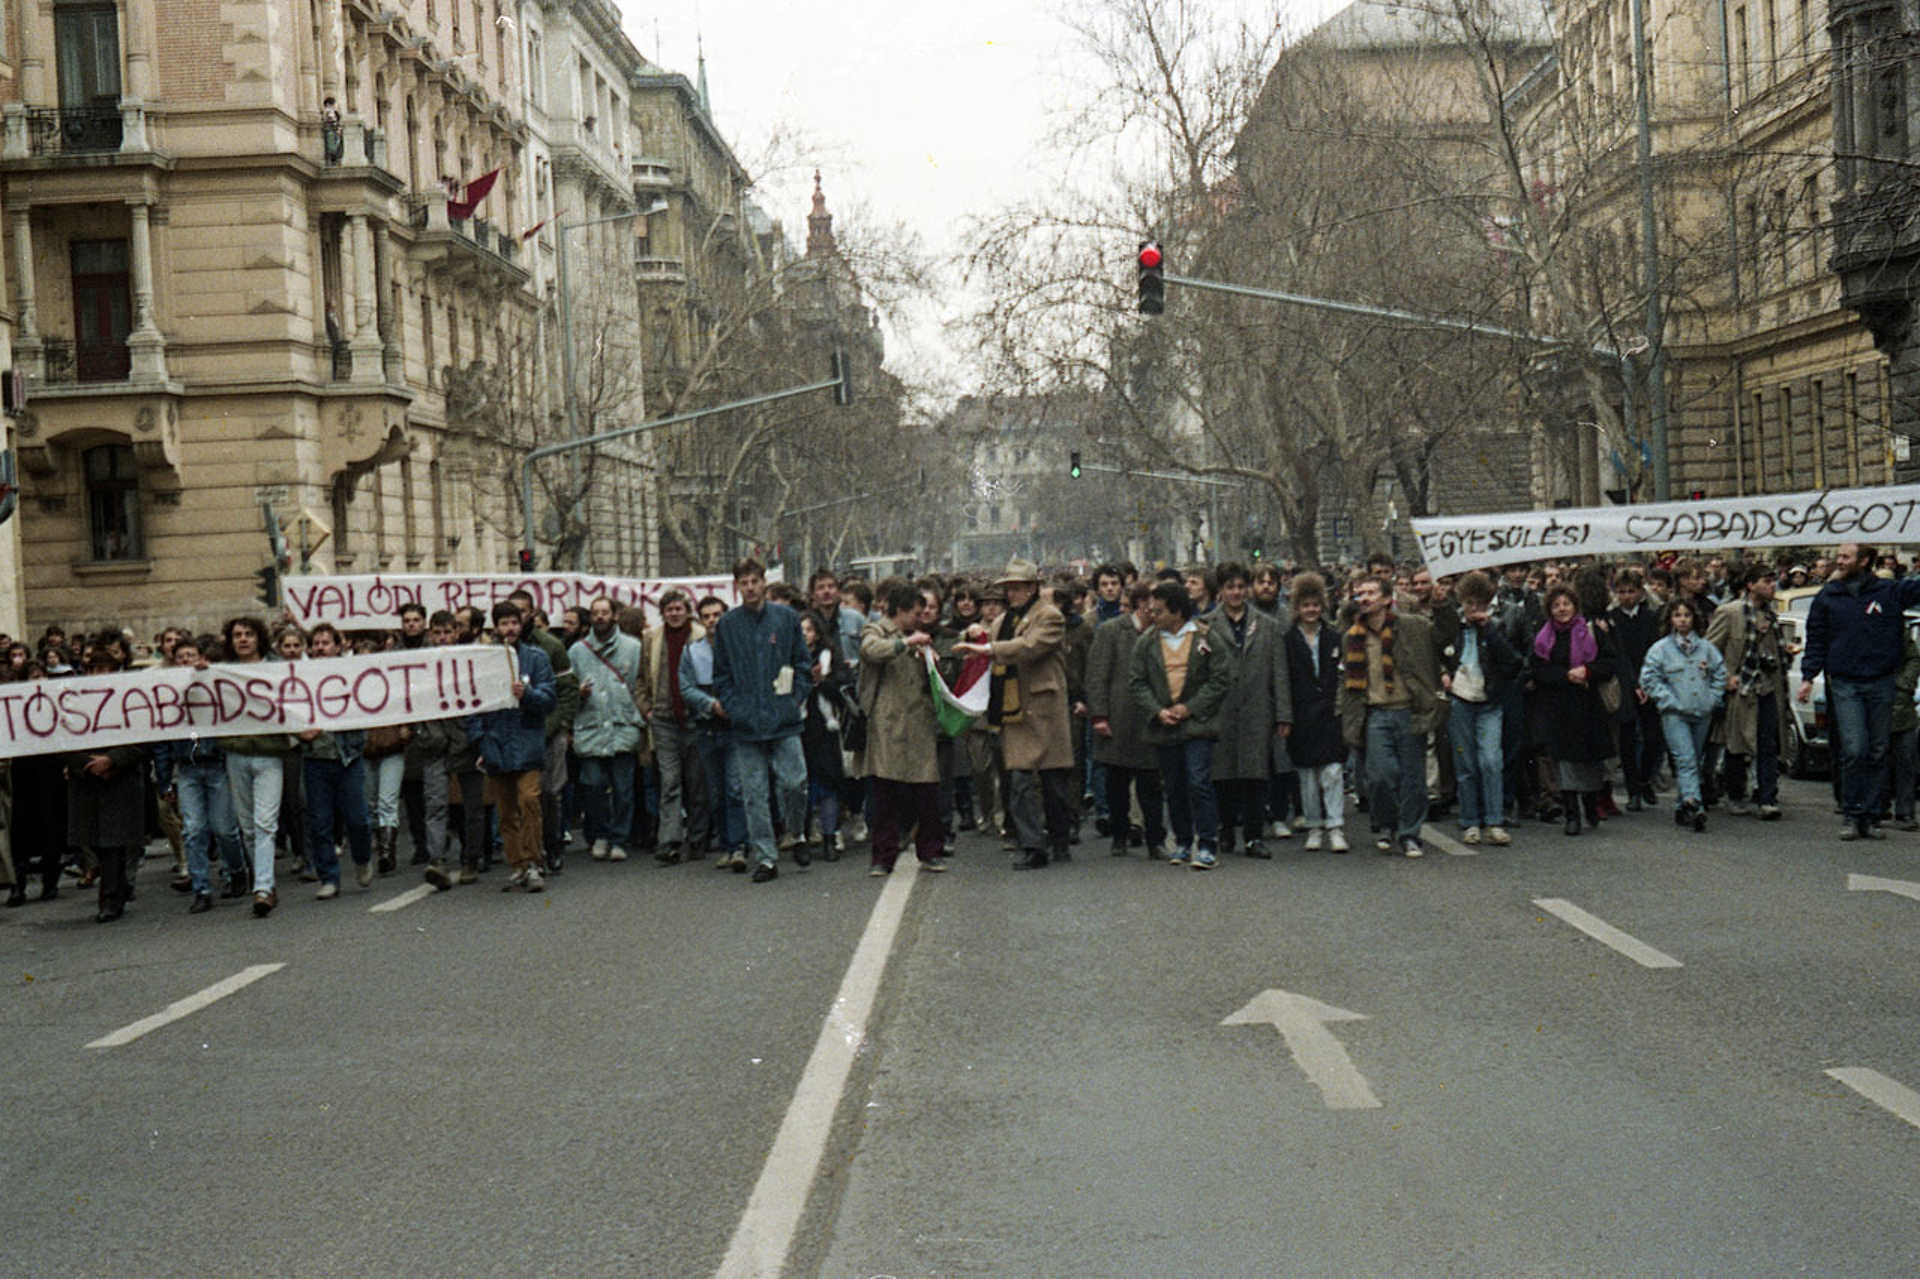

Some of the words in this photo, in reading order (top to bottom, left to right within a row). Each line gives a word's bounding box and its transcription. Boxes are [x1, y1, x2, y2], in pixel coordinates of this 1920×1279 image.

[1421, 518, 1590, 563] EGYESÜLÉSI
[1617, 490, 1920, 543] SZABADSÁGOT
[288, 576, 422, 620] VALÓDI
